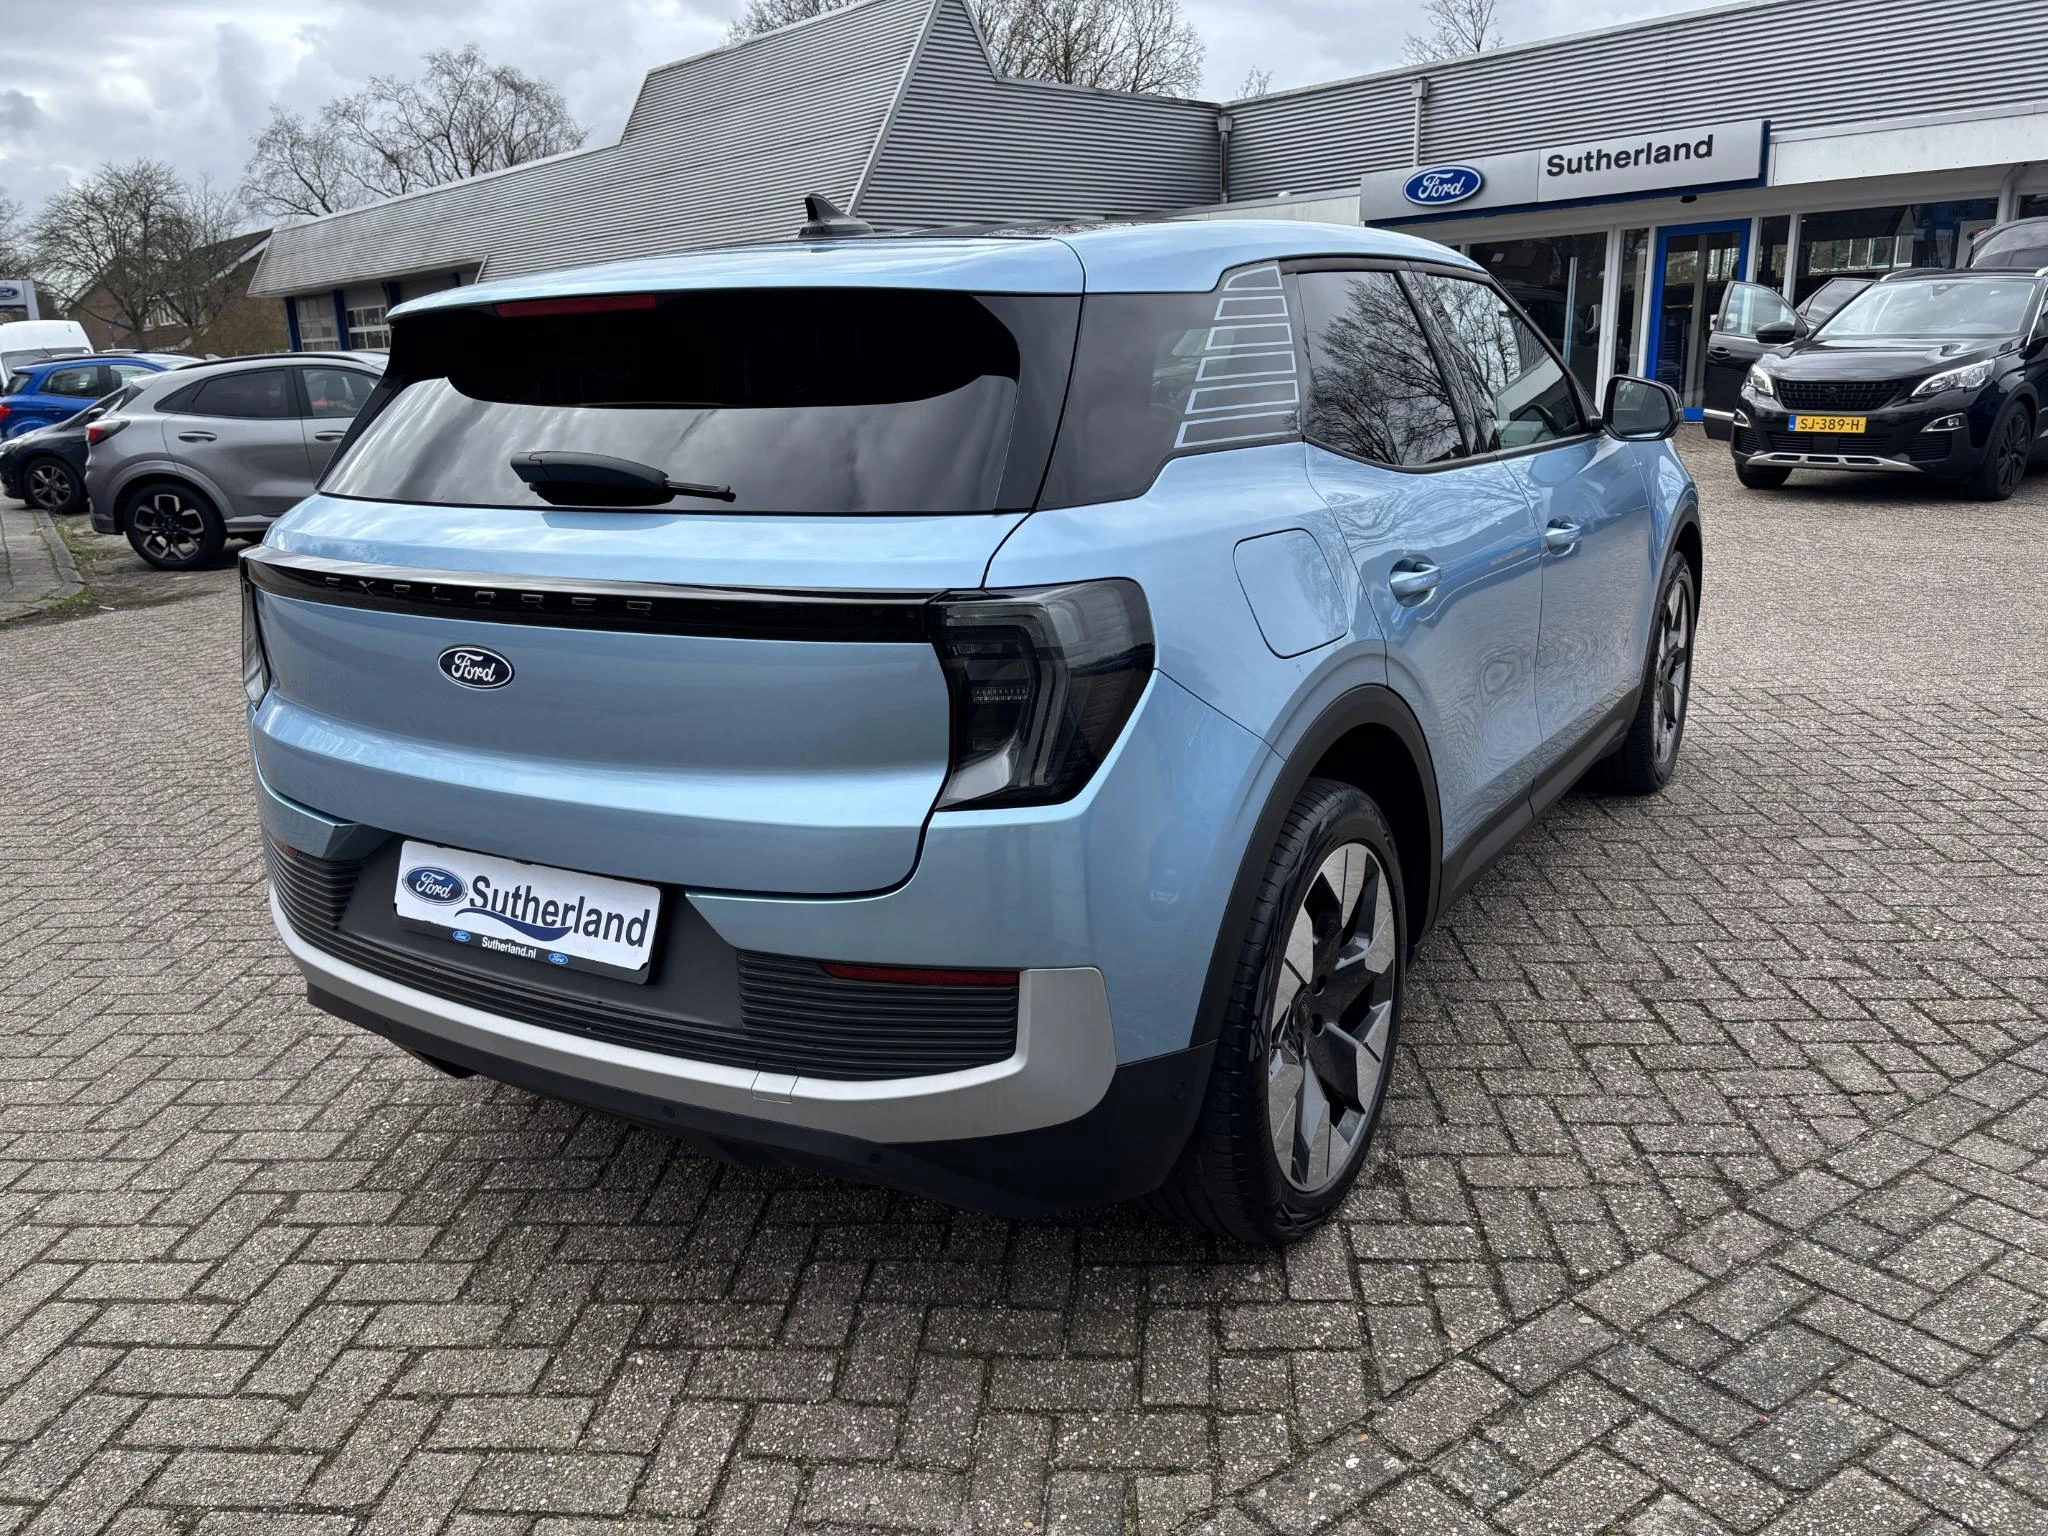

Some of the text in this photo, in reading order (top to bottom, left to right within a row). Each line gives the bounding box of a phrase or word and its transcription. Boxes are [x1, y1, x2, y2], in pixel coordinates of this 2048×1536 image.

[1546, 134, 1715, 177] Sutherland
[1418, 171, 1466, 199] Ford
[1800, 418, 1860, 431] SJ-389-H
[324, 576, 654, 617] EXPLORER
[451, 651, 497, 683] Ford
[415, 871, 452, 899] Ford
[469, 875, 651, 948] Sutherland
[481, 936, 537, 960] Sutherland.nl
